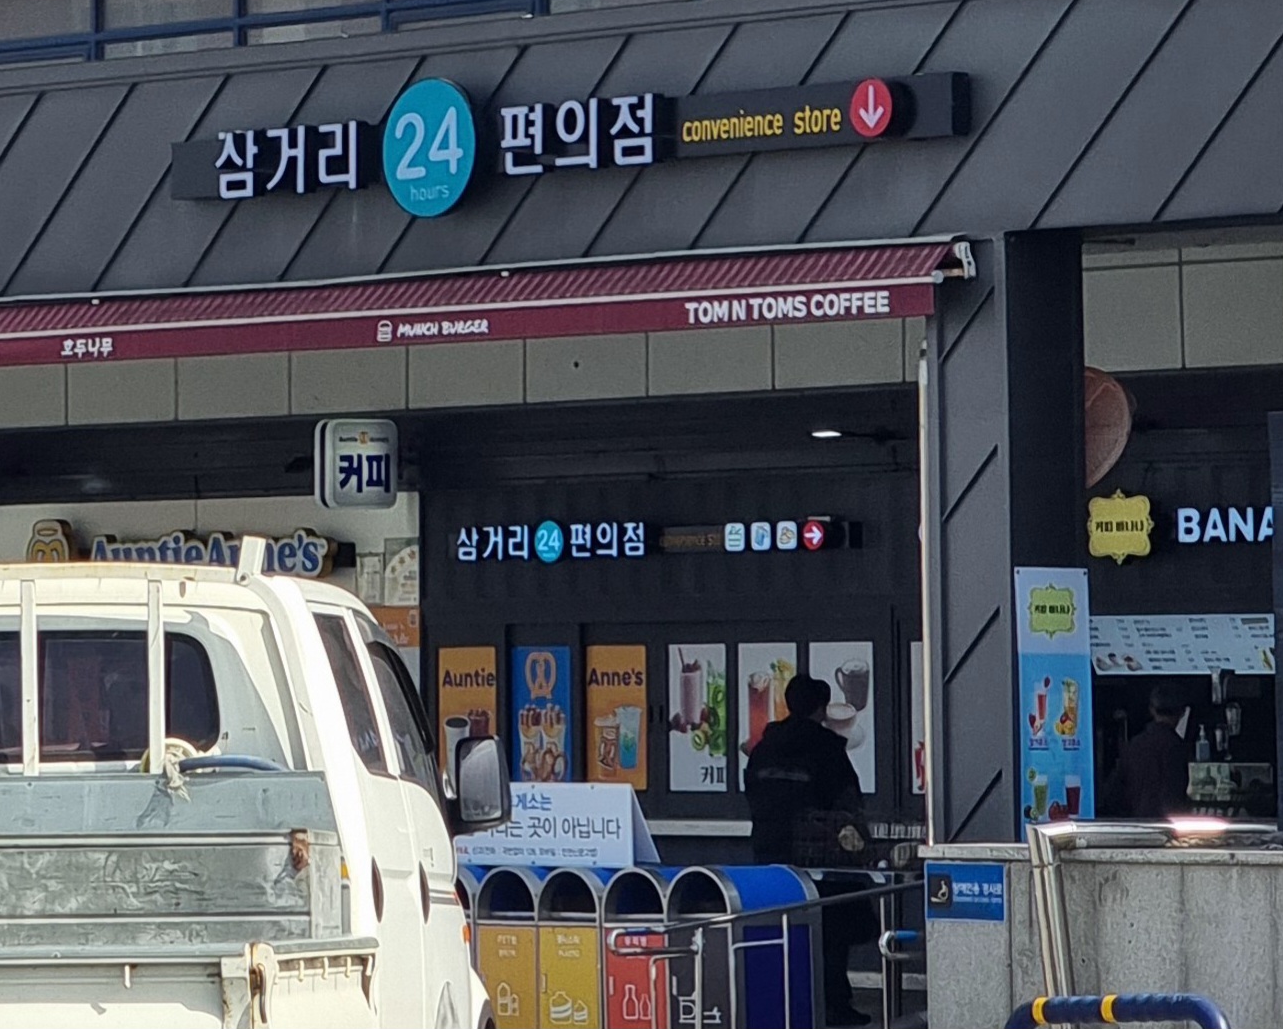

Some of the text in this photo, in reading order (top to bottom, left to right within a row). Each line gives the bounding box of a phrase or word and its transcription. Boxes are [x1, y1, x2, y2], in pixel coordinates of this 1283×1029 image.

[682, 104, 842, 143] convenience store
[215, 92, 655, 200] 삼거리 24 편의점
[410, 182, 450, 202] hours
[685, 290, 891, 325] TOM N TOMS COFFEE
[397, 319, 489, 339] MUNCH BURGER
[60, 337, 114, 358] 호두나무
[339, 453, 391, 493] 커피
[93, 533, 204, 564] Auntie
[456, 525, 530, 562] 삼거리
[537, 529, 562, 554] 24
[570, 521, 646, 558] 편의점
[442, 665, 644, 689] Auntie Anne's
[512, 792, 552, 811] 게소는
[527, 816, 558, 839] 곳이
[562, 816, 622, 839] 아닙니다
